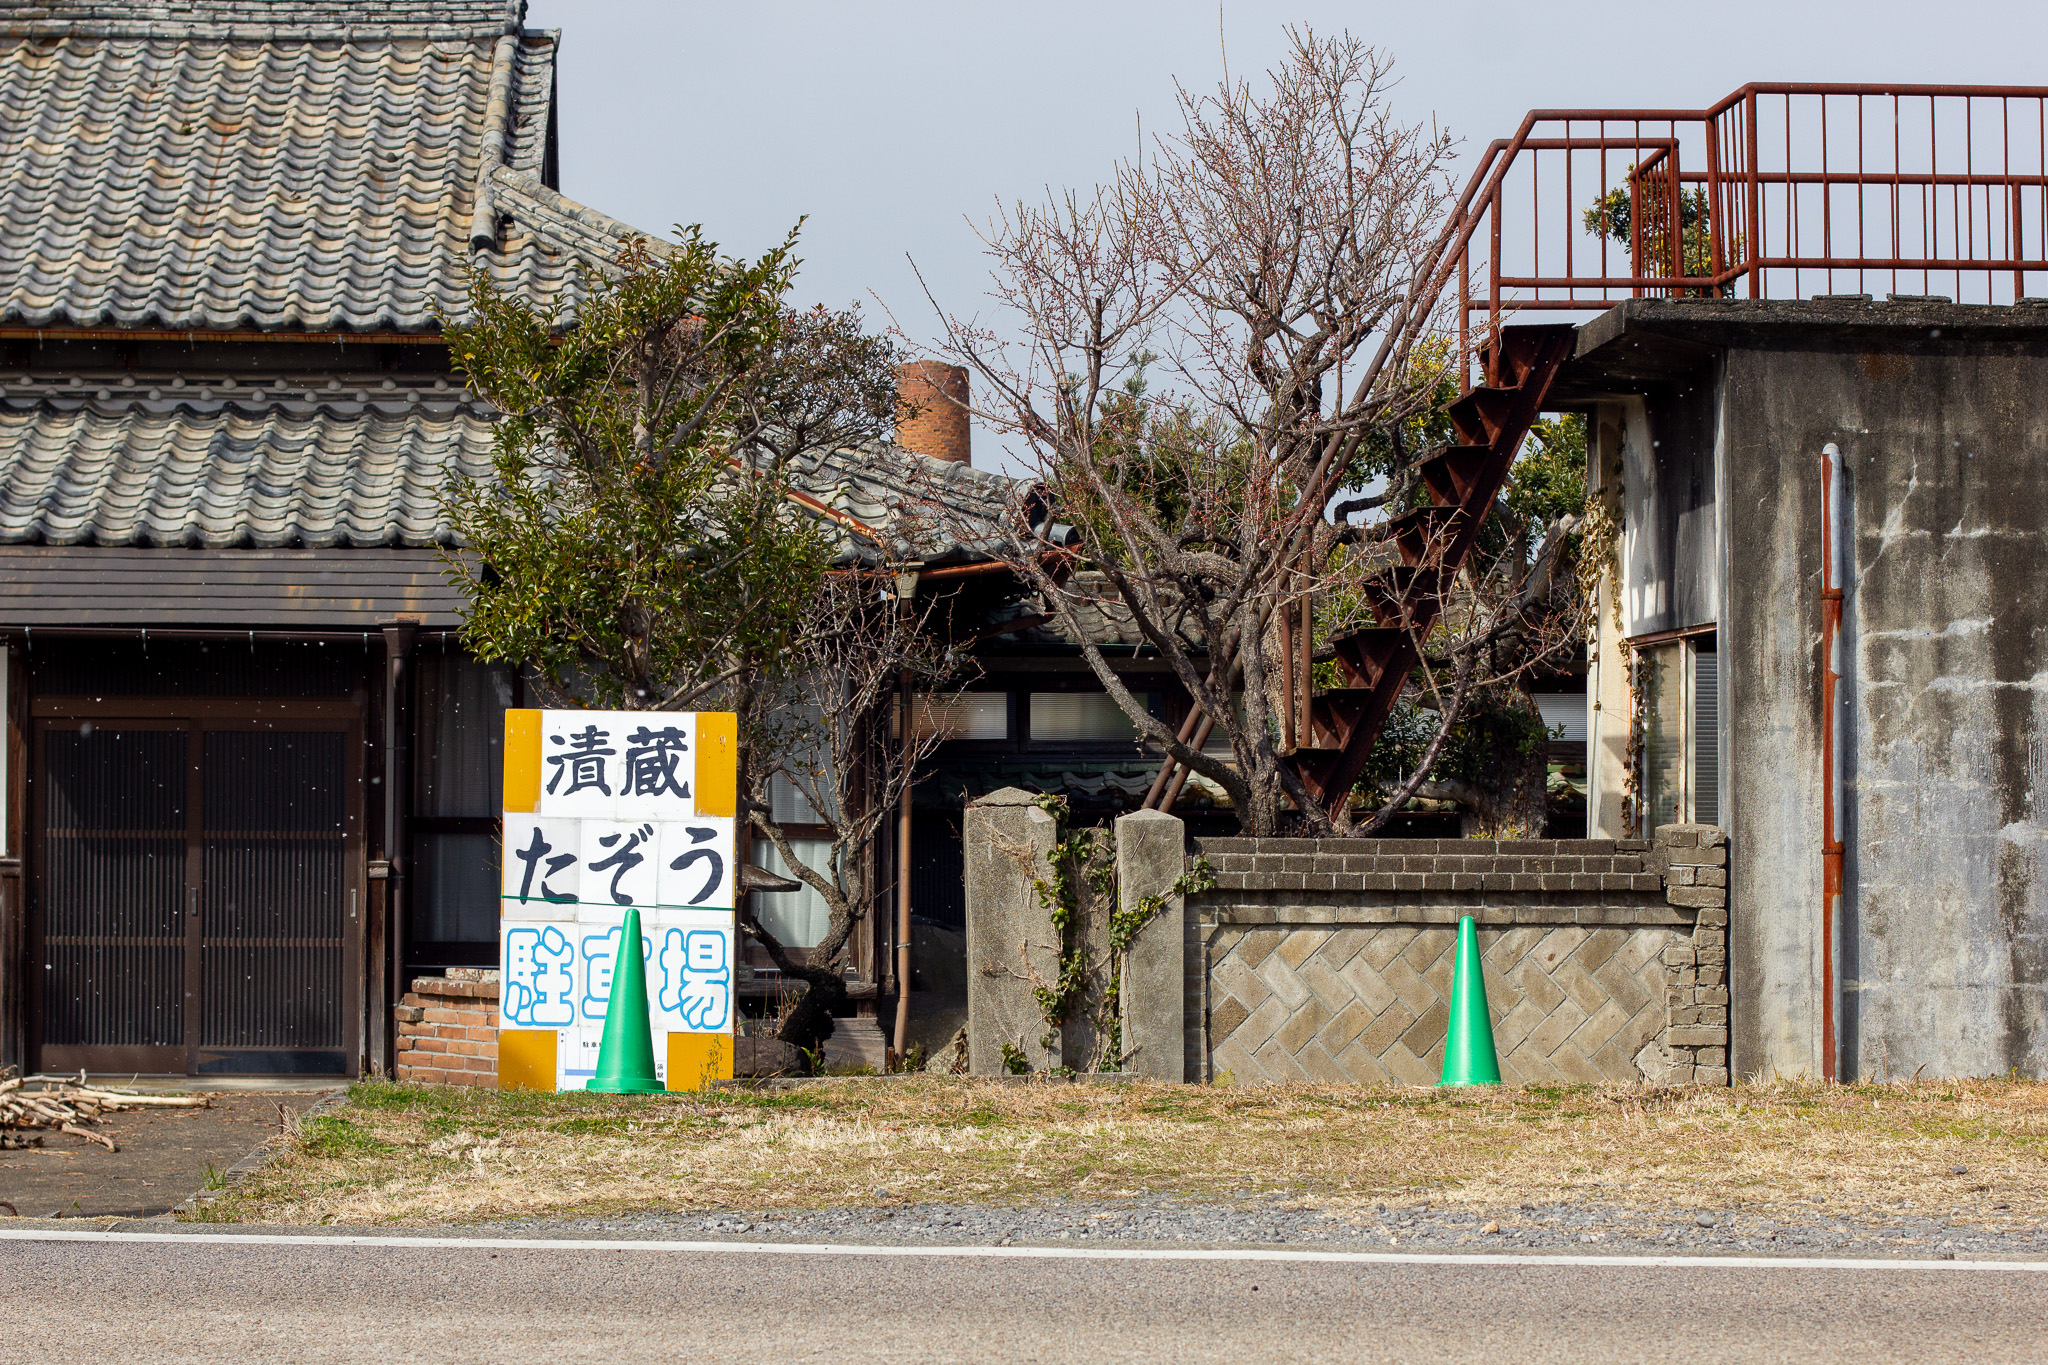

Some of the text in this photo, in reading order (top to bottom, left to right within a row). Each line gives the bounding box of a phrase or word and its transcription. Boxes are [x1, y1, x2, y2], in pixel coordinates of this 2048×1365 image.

[547, 725, 692, 798] 漬蔵
[514, 823, 724, 905] たぞう
